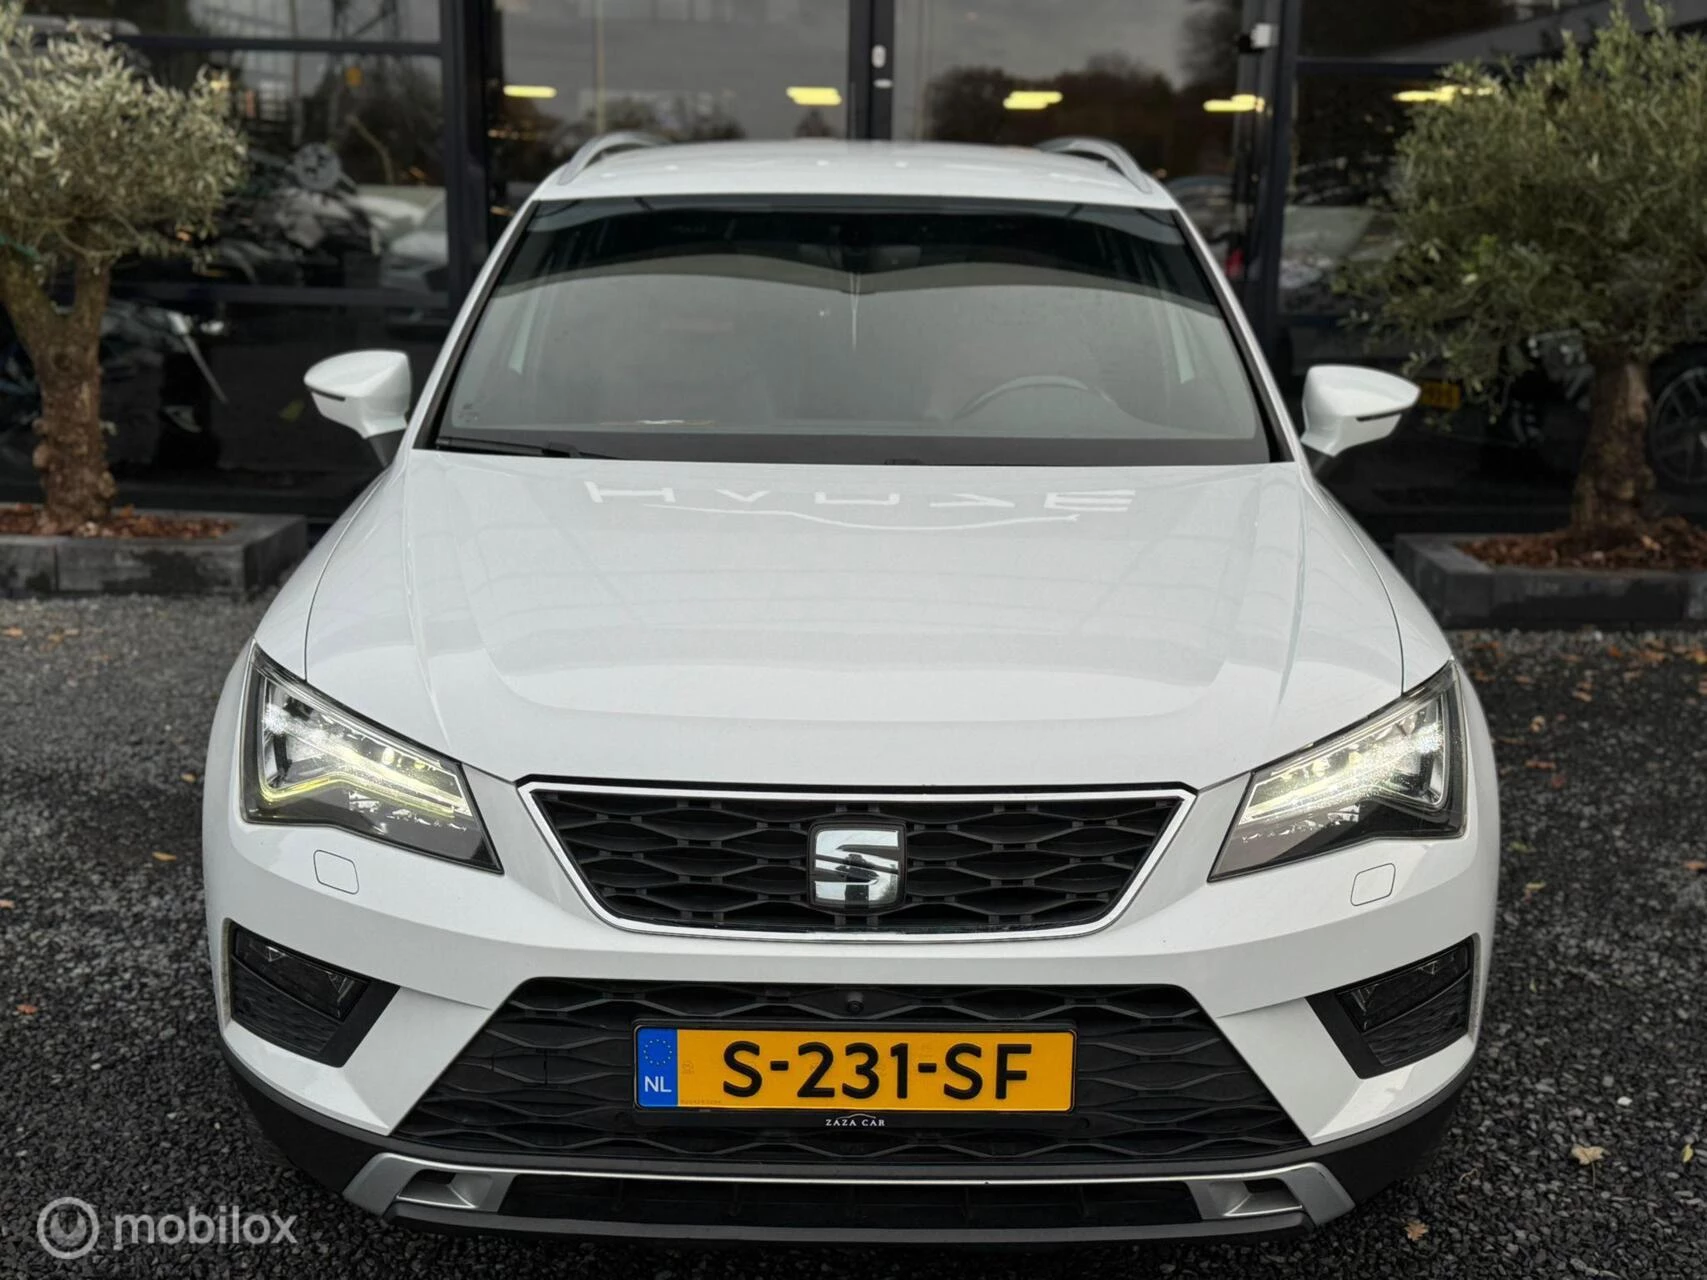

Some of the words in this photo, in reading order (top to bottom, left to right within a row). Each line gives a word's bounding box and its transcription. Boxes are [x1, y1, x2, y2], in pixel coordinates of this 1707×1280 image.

[722, 1040, 1032, 1100] S-231-SF
[644, 1075, 672, 1093] NL
[825, 1119, 857, 1127] ZAZA
[861, 1119, 885, 1127] CAR
